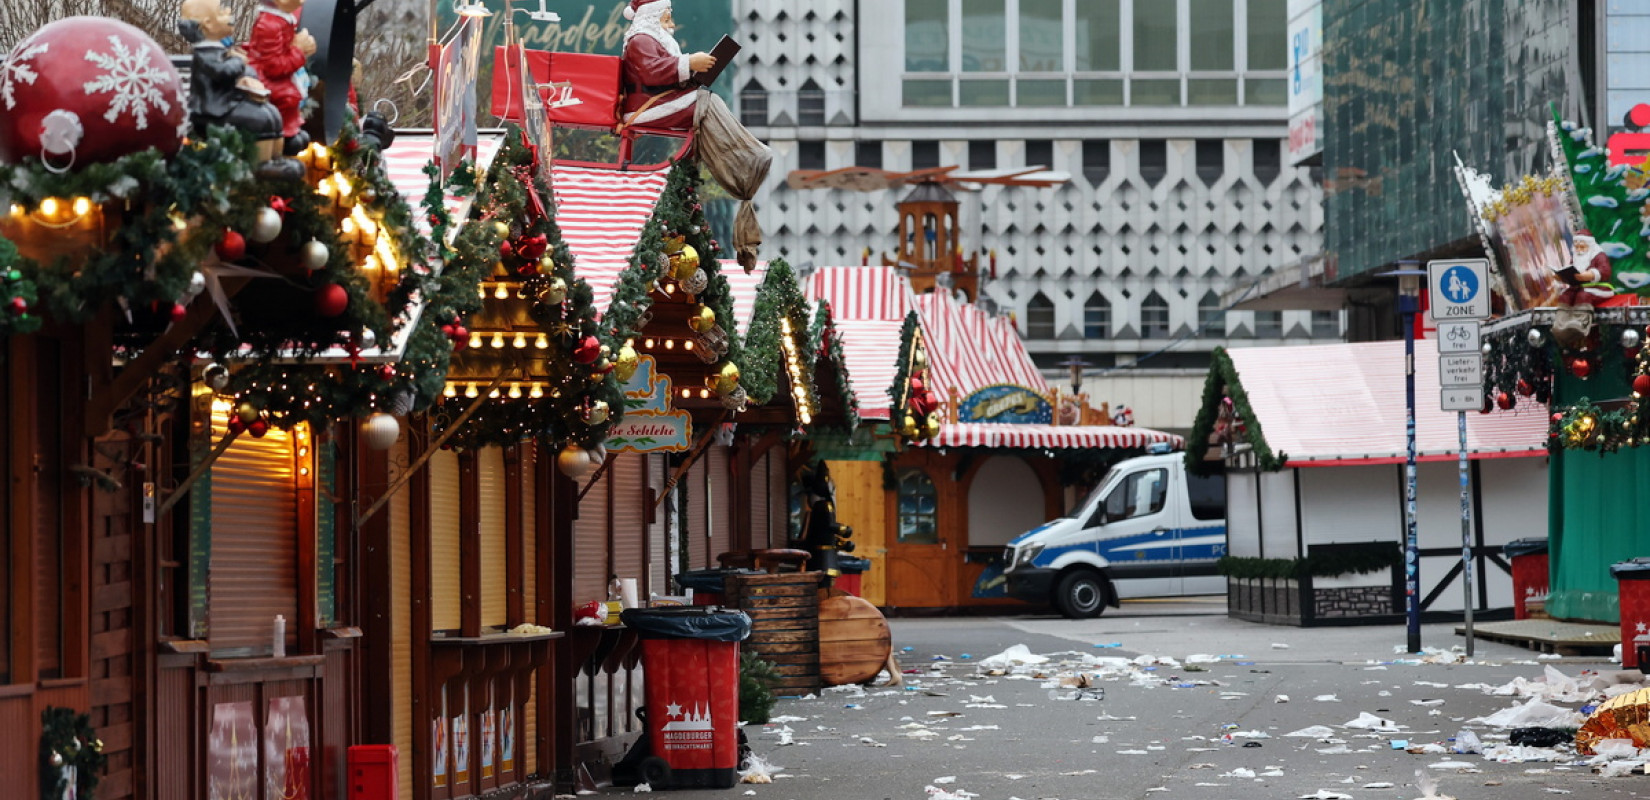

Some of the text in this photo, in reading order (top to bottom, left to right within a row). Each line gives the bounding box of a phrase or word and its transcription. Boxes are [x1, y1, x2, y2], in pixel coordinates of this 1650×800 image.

[1446, 305, 1475, 316] ZONE
[1452, 341, 1467, 349] frei
[1447, 358, 1474, 366] Liefer-
[1446, 365, 1476, 374] verkehr
[1454, 374, 1468, 382] frei
[626, 424, 676, 436] Schlehe
[664, 732, 713, 740] MAGDEBURGER
